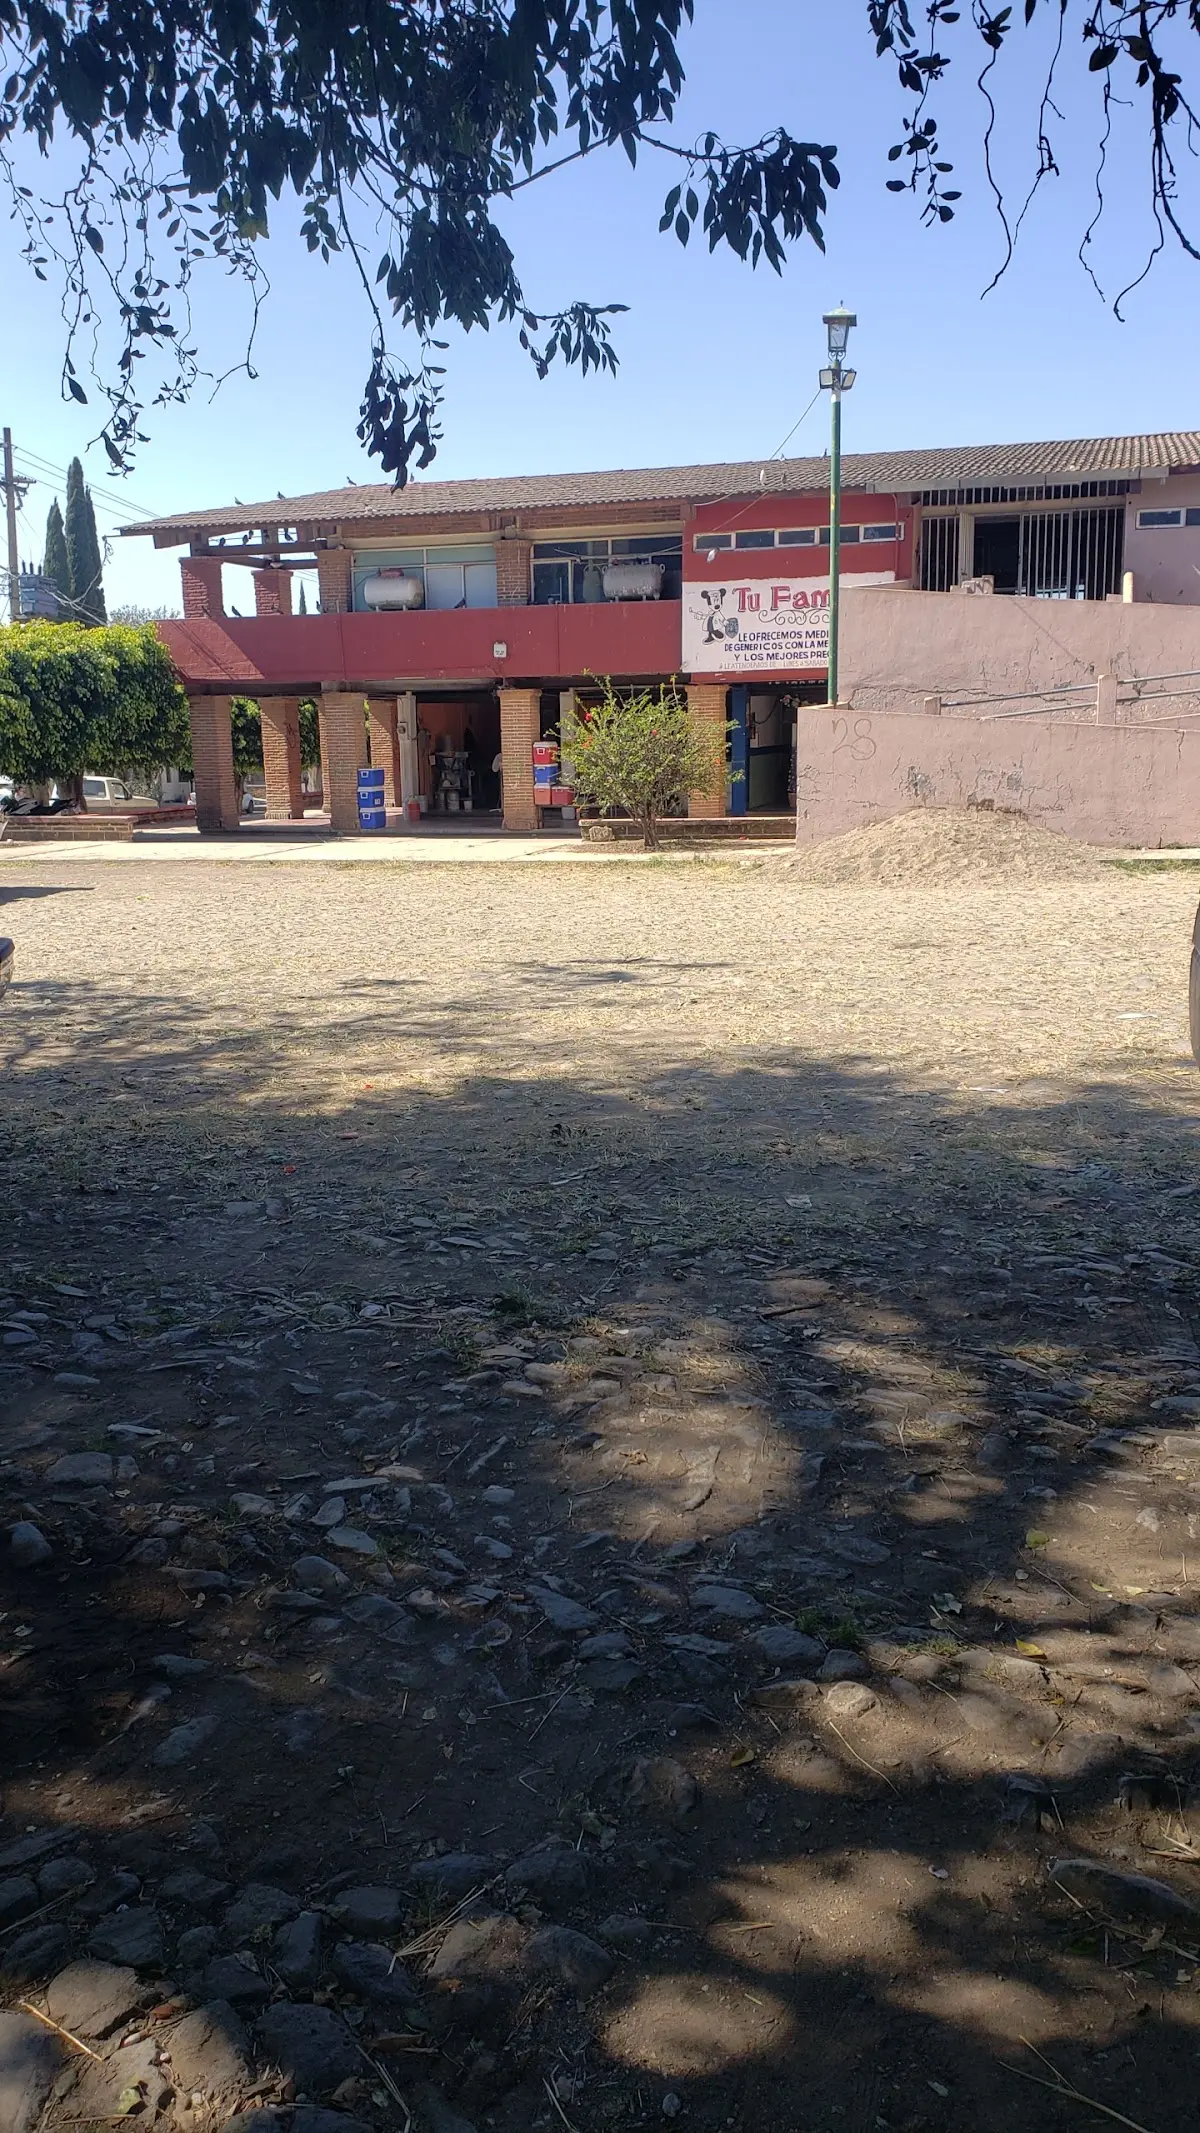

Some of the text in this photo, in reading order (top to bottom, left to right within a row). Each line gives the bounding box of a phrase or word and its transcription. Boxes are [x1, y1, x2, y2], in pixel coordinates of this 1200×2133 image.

[732, 587, 761, 613] Tu
[738, 633, 747, 642] LE
[749, 630, 803, 642] OFRECEMOS
[725, 643, 732, 652] DE
[734, 642, 783, 652] GENERICOS
[785, 641, 803, 650] CON
[805, 640, 815, 649] LA
[744, 653, 764, 661] LOS
[766, 651, 809, 661] MEJORES
